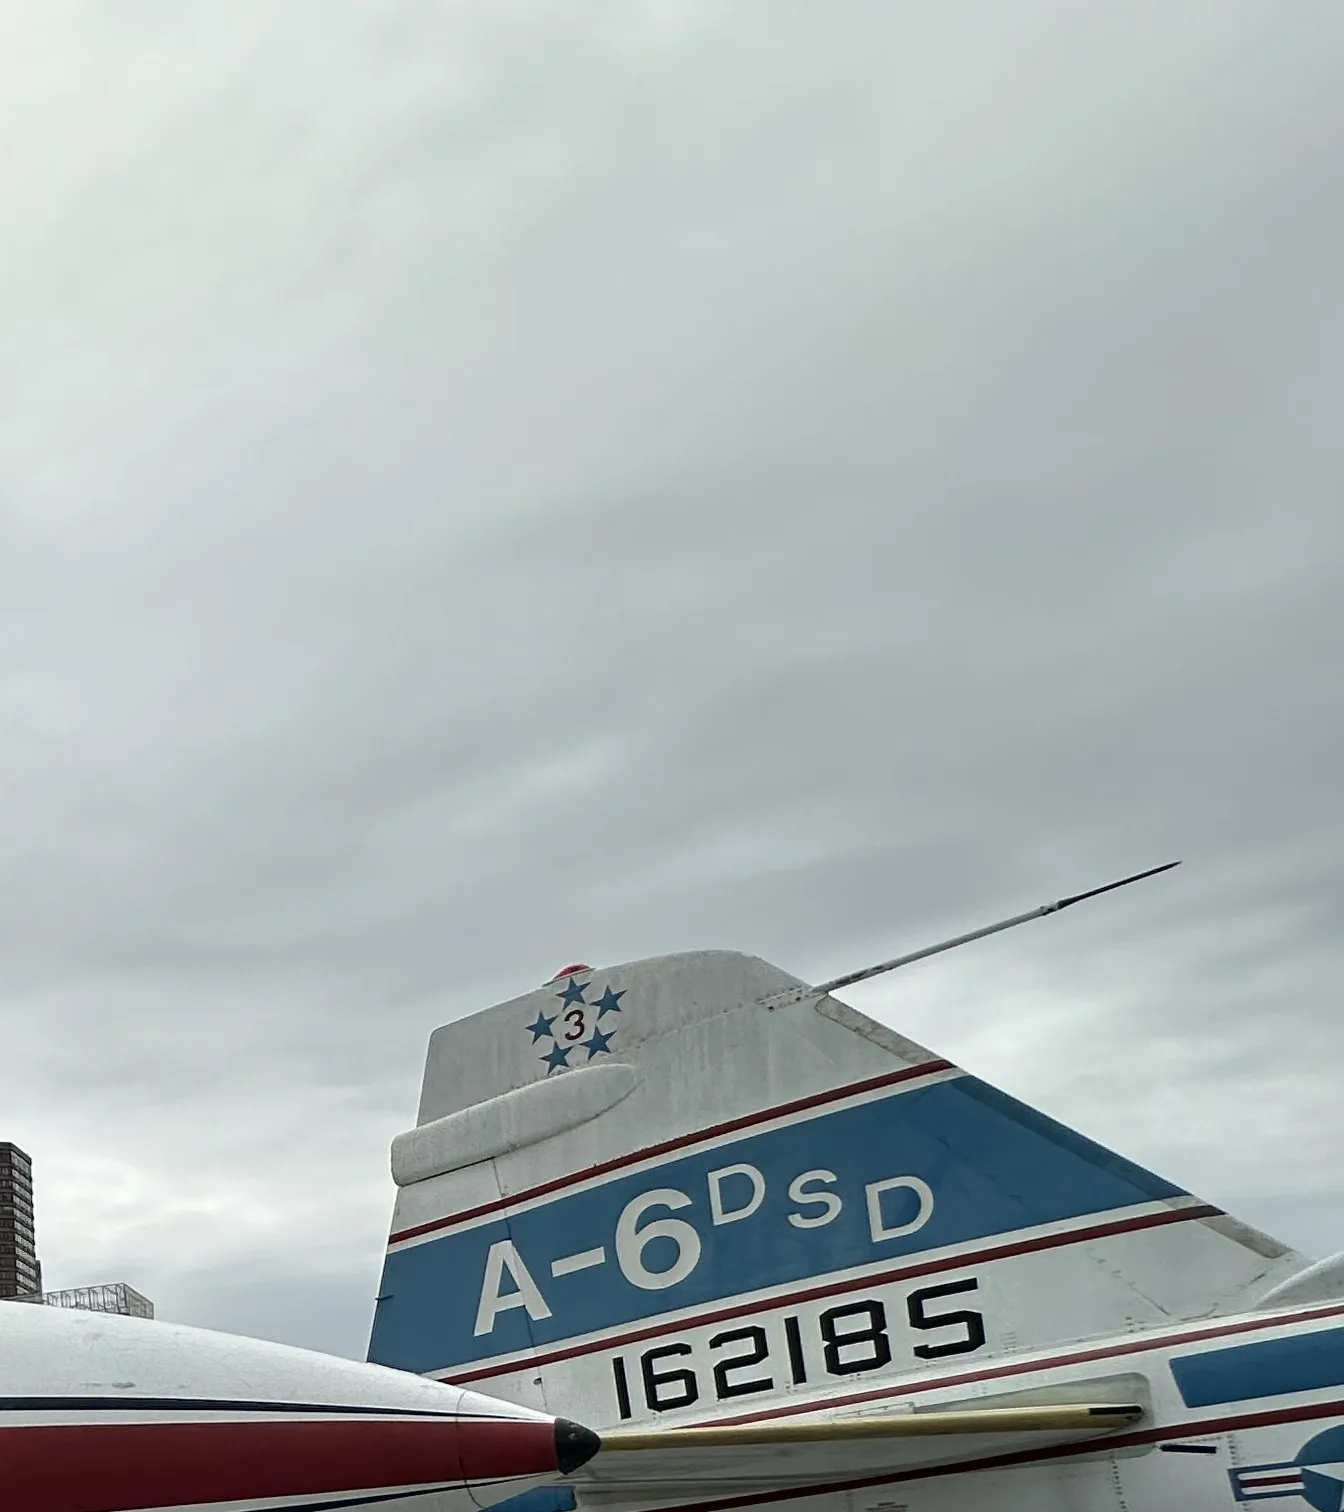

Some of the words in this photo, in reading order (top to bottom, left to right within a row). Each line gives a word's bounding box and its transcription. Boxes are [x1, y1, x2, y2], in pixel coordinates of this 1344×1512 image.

[564, 1009, 585, 1041] 3
[473, 1188, 702, 1338] A-6
[613, 1278, 986, 1420] 162185
